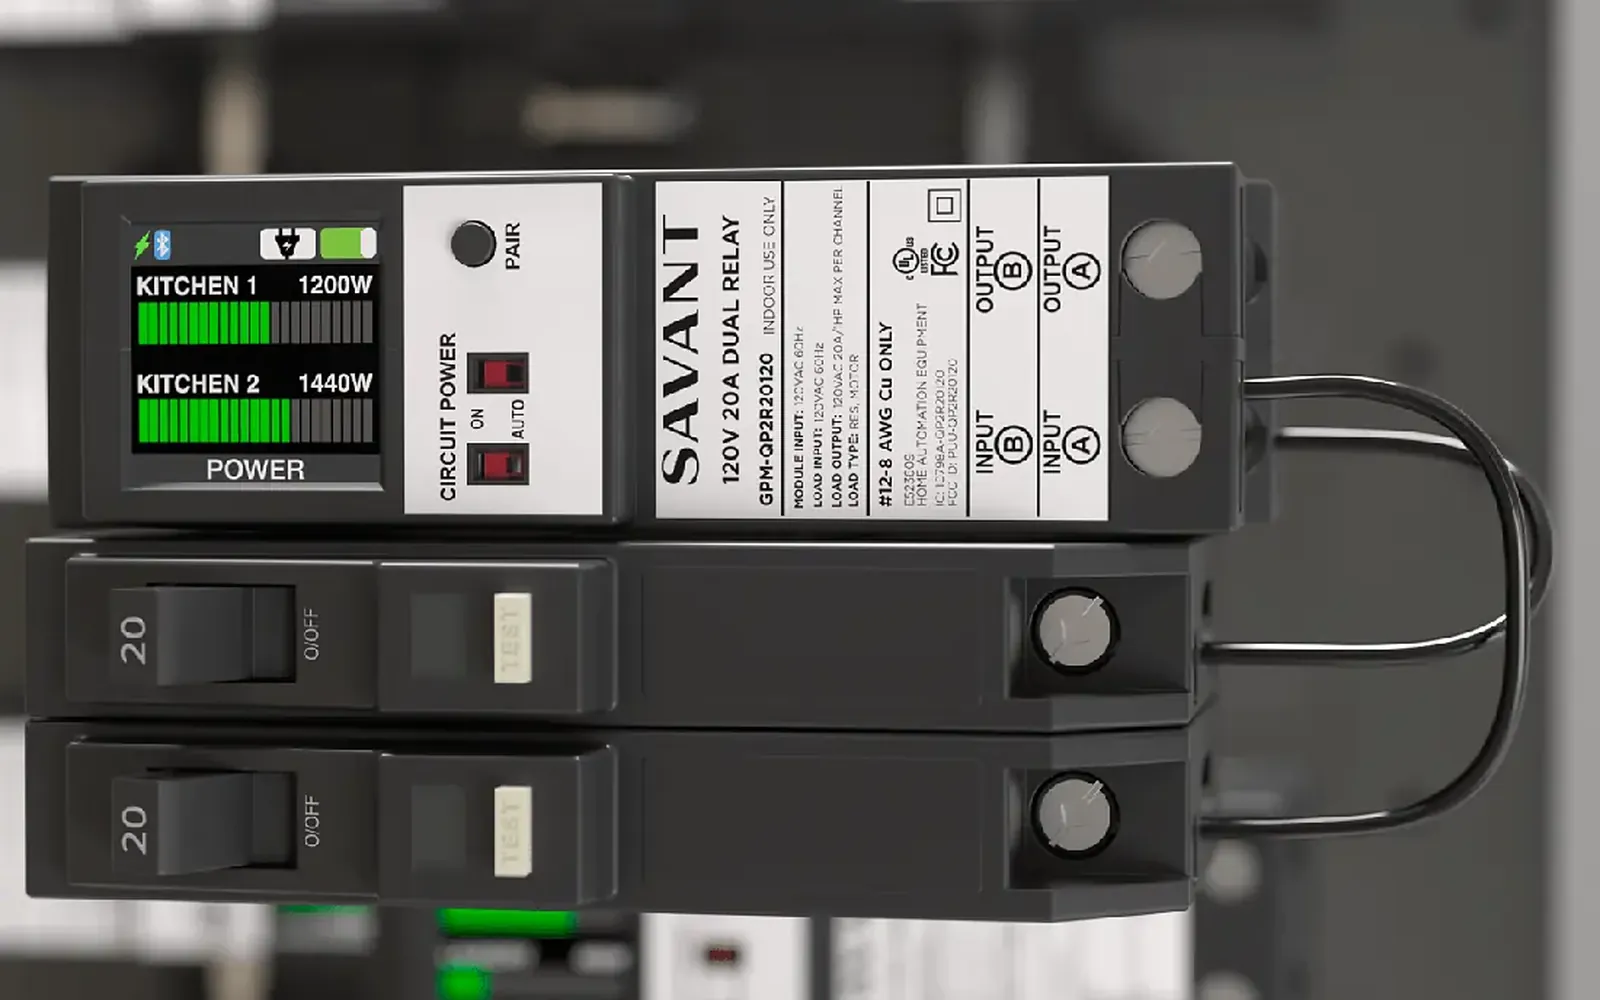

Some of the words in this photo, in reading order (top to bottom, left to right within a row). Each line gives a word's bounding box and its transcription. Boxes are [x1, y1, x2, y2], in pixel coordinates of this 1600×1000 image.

[763, 196, 775, 236] ONLY
[833, 185, 843, 245] CHANNEL
[505, 222, 520, 270] PAIR
[722, 215, 739, 291] RELAY
[763, 241, 775, 270] USE
[833, 249, 843, 273] PER
[976, 226, 993, 313] OUTPUT
[1043, 225, 1060, 312] OUTPUT
[136, 275, 239, 296] KITCHEN
[247, 276, 256, 295] 1
[299, 275, 373, 294] 1200W
[763, 274, 775, 335] INDOOR
[833, 277, 843, 304] MAX
[662, 215, 699, 485] SAVANT
[722, 299, 739, 364] DUAL
[879, 321, 893, 371] ONLY
[916, 303, 927, 377] EQUPMENT
[136, 374, 240, 394] KITCHEN
[246, 374, 260, 394] 2
[299, 373, 373, 393] 1440W
[440, 333, 456, 410] POWER
[879, 378, 893, 401] Cu
[471, 408, 484, 429] ON
[511, 399, 525, 439] AUTO
[722, 373, 739, 421] 20A
[759, 353, 774, 505] GPM-QP2R20120
[794, 410, 804, 451] INPUT:
[832, 415, 842, 469] OUTPUT:
[879, 408, 893, 452] AWG
[916, 383, 927, 465] AUTOMATION
[976, 410, 993, 473] INPUT
[1044, 409, 1060, 473] INPUT
[207, 459, 305, 480] POWER
[440, 418, 456, 501] CIRCUIT
[722, 429, 739, 484] 120V
[813, 428, 823, 469] INPUT:
[849, 434, 859, 468] TYPE:
[948, 462, 957, 478] D:
[794, 455, 804, 508] MODULE
[813, 472, 823, 508] LOAD
[832, 472, 842, 508] LOAD
[849, 472, 859, 507] LOAD
[879, 458, 893, 507] #12-8
[916, 470, 927, 506] HOME
[948, 481, 957, 506] FCC
[120, 615, 146, 665] 20
[500, 607, 520, 671] TEST
[121, 805, 147, 855] 20
[500, 800, 520, 866] TEST
